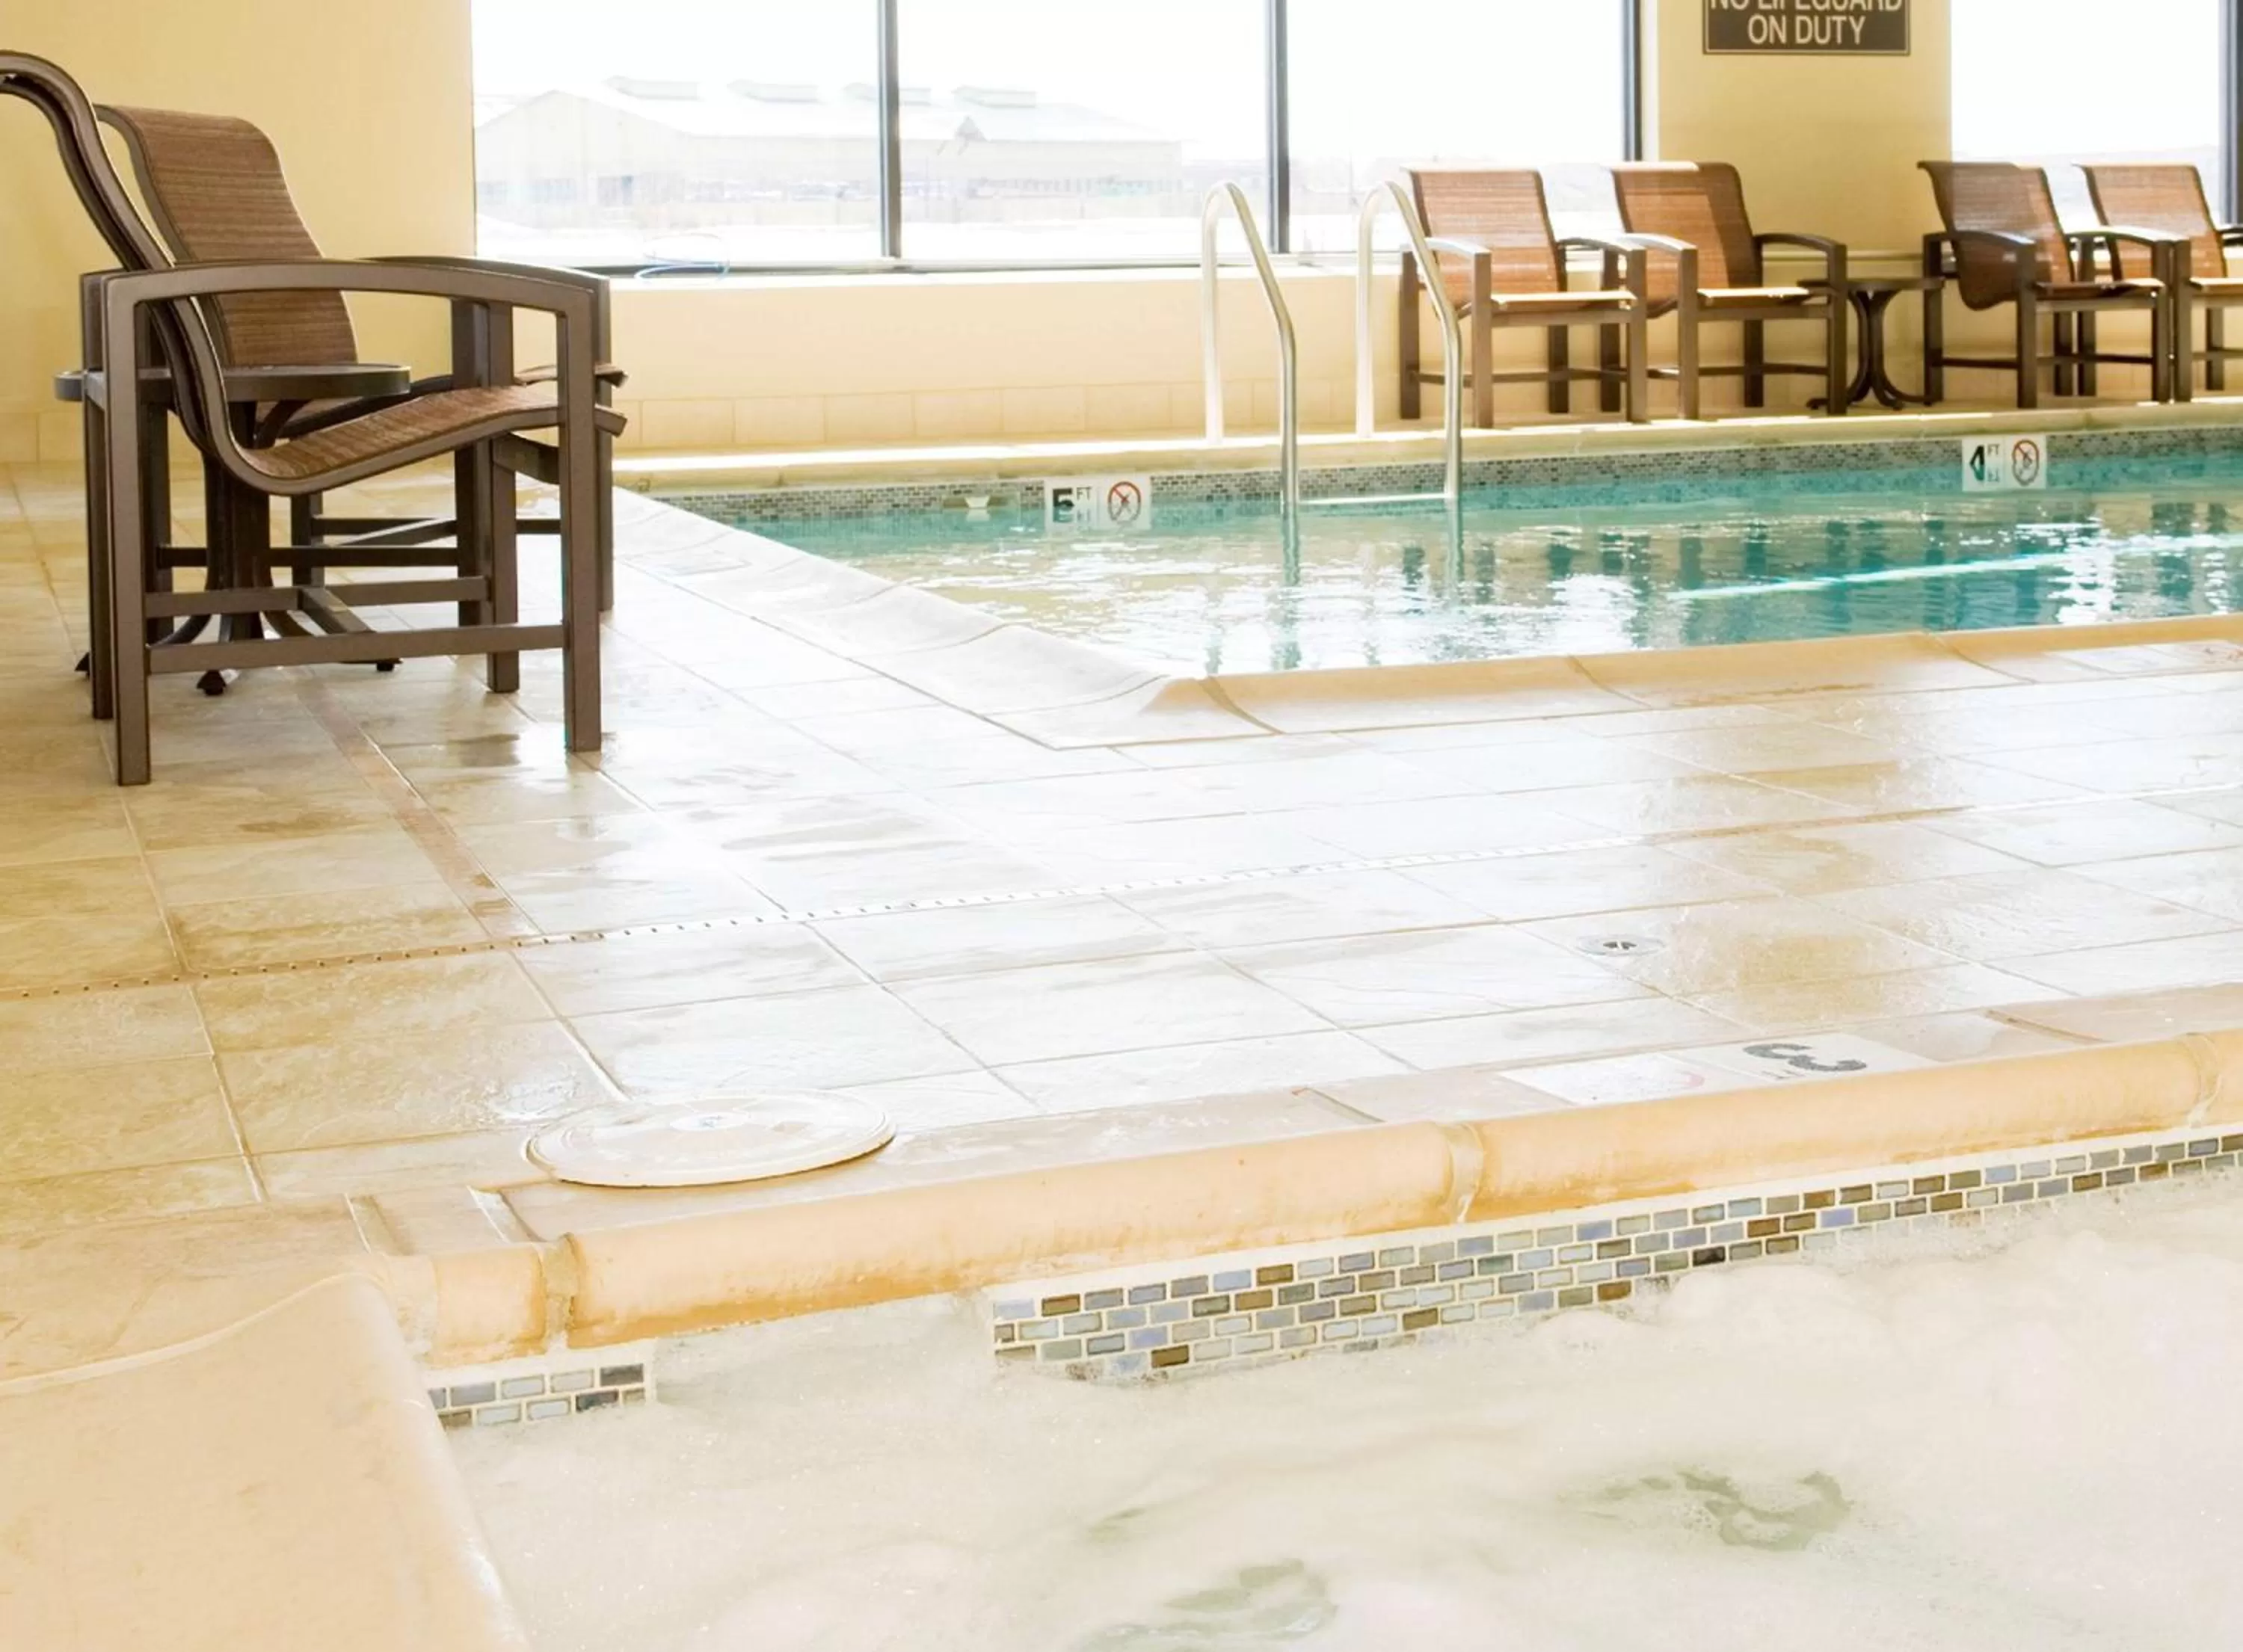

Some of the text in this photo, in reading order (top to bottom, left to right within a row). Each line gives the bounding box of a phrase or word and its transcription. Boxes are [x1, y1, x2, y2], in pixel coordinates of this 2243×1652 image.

[1747, 14, 1866, 44] ON DUTY
[1077, 487, 1092, 500] FT
[1743, 1043, 1867, 1072] 3
